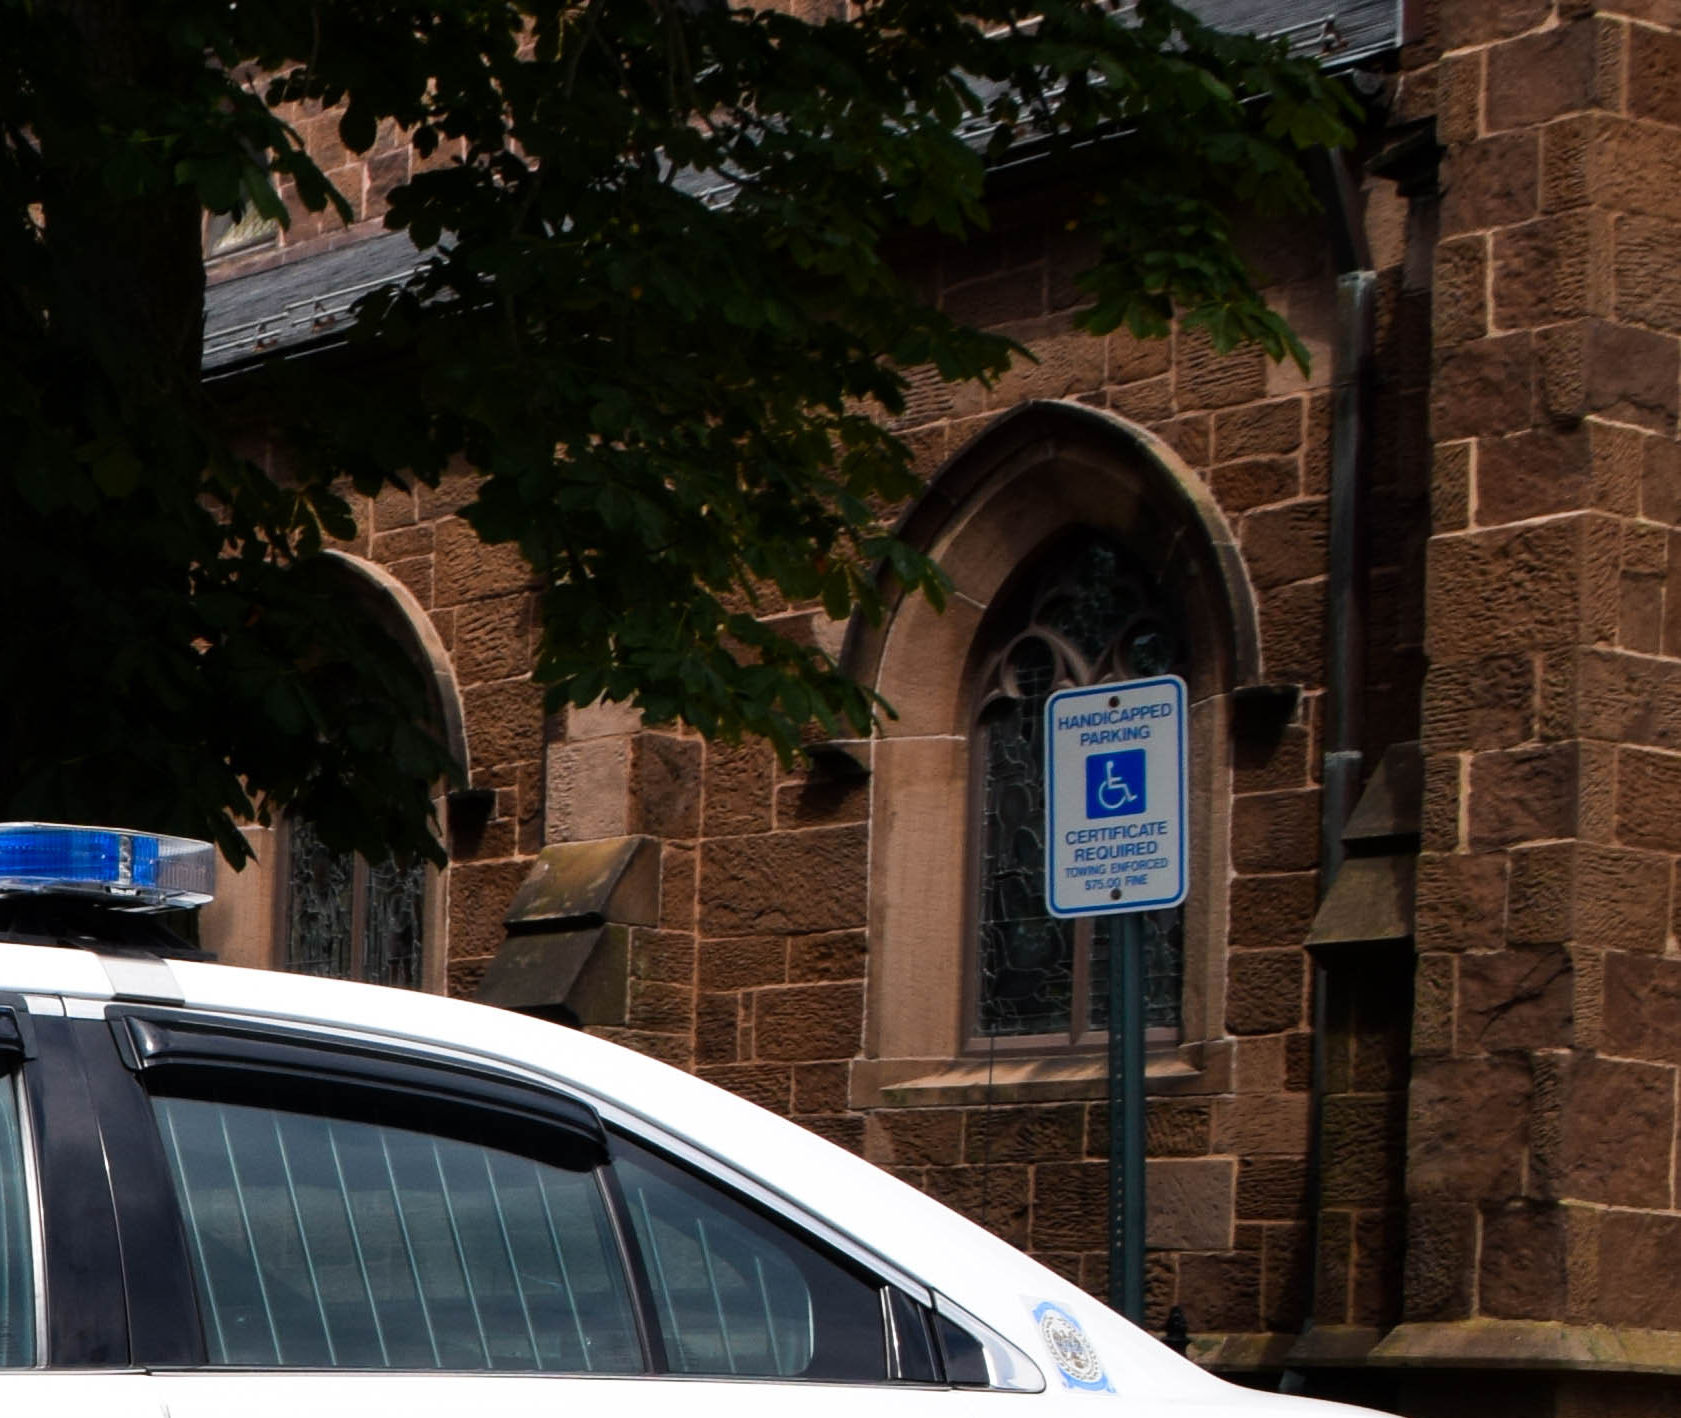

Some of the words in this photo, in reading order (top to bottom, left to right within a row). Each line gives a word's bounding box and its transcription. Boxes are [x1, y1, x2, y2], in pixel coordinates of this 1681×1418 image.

[1058, 703, 1173, 730] HANDICAPPED
[1080, 725, 1151, 746] PARKING
[1065, 821, 1168, 845] CERTIFICATE
[1074, 841, 1158, 862] REQUIRED
[1064, 864, 1107, 878] TOWING
[1110, 858, 1169, 873] ENFORCED
[1085, 877, 1121, 890] $75.00
[1125, 874, 1148, 886] FINE
